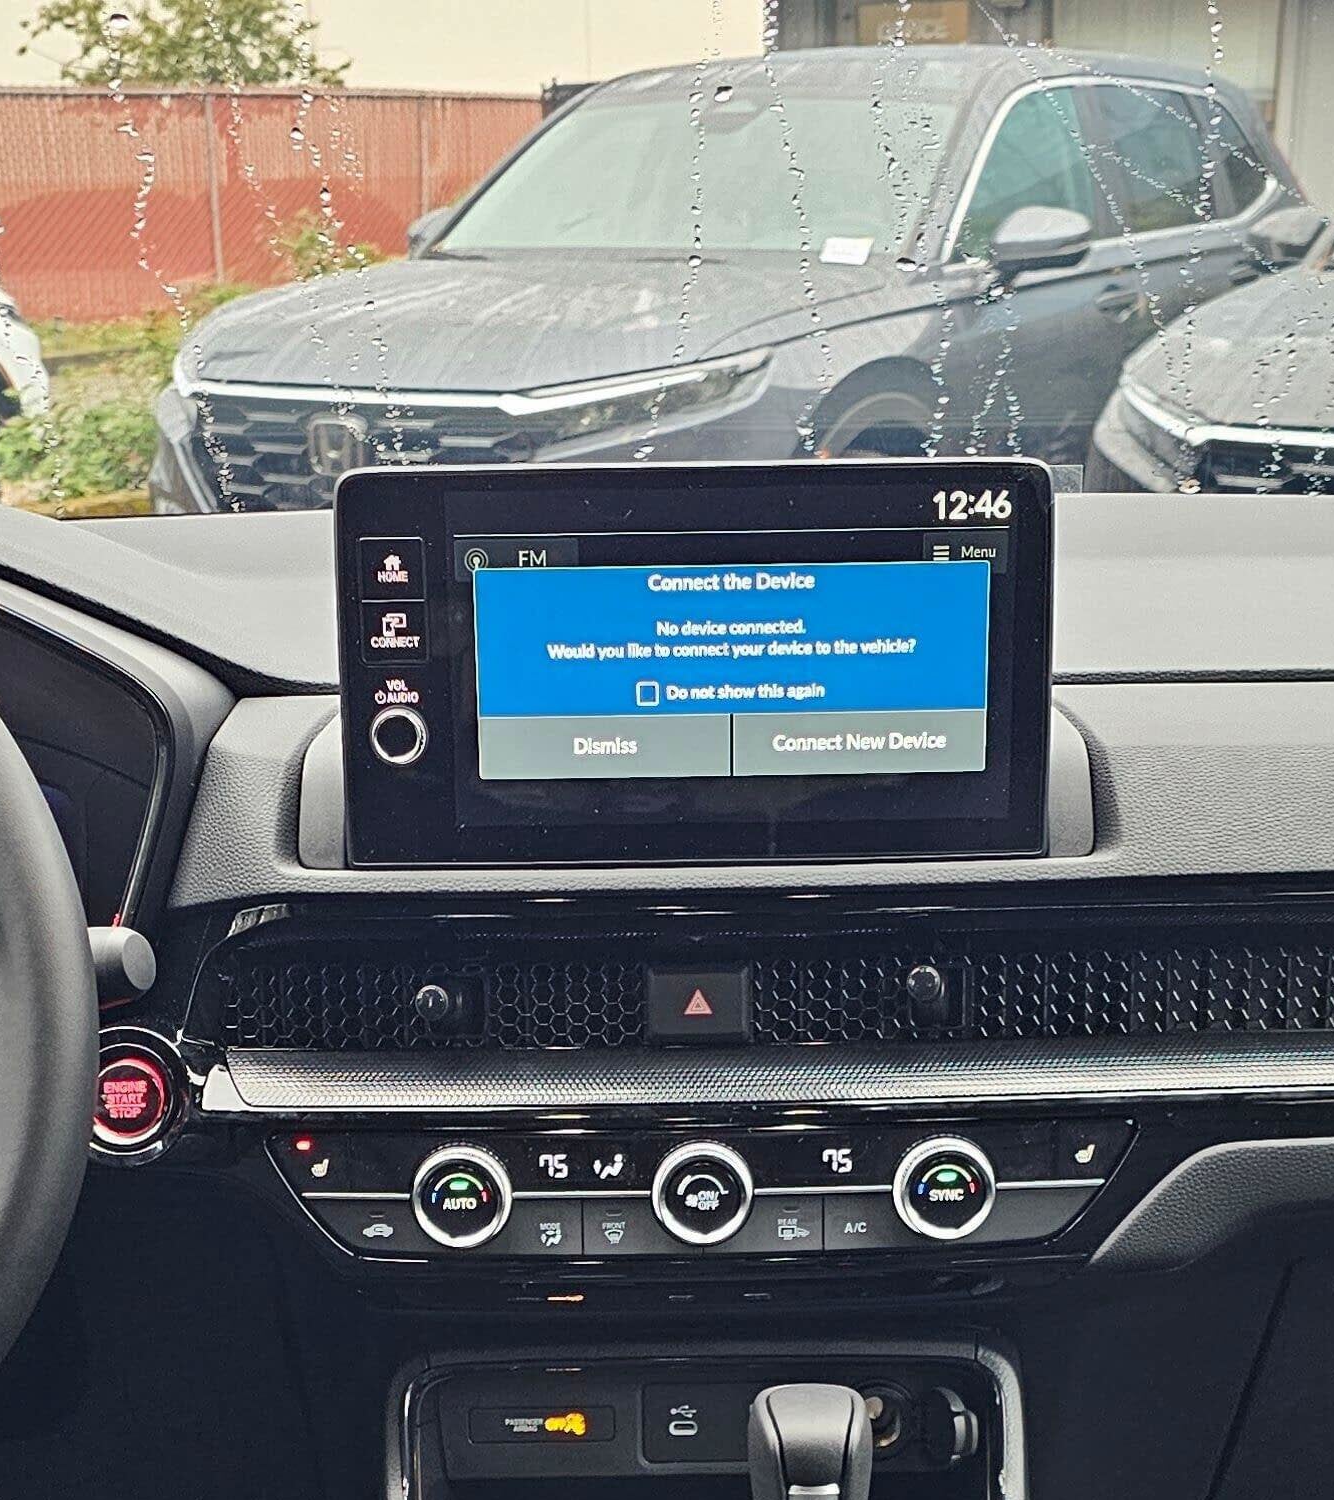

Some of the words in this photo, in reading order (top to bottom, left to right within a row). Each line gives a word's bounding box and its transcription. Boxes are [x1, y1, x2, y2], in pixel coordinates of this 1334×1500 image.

[932, 489, 1012, 520] 12:46
[961, 545, 996, 558] Menu
[518, 549, 547, 568] FM
[377, 571, 409, 584] HOME
[647, 573, 720, 592] Connect
[723, 573, 752, 590] the
[755, 571, 816, 590] Device
[656, 621, 679, 636] No
[680, 619, 728, 636] device
[728, 618, 806, 635] connected.
[370, 636, 421, 649] CONNECT
[547, 643, 595, 660] Would
[598, 645, 624, 661] you
[627, 642, 652, 658] like
[654, 643, 671, 658] to
[672, 642, 730, 658] connect
[731, 642, 765, 659] your
[766, 639, 813, 656] device
[814, 640, 831, 655] to
[833, 638, 859, 654] the
[860, 637, 917, 654] vehicle?
[385, 679, 409, 692] VOL
[665, 684, 687, 700] Do
[690, 685, 716, 700] not
[717, 683, 756, 699] show
[757, 682, 785, 699] this
[787, 683, 826, 700] again
[386, 691, 420, 704] AUDIO
[573, 737, 638, 756] Dismiss
[772, 732, 843, 752] Connect
[845, 731, 887, 751] New
[889, 730, 947, 750] Device
[103, 1080, 147, 1093] ENGINE
[106, 1092, 144, 1105] START
[109, 1106, 142, 1119] STOP
[538, 1153, 569, 1179] 75
[822, 1148, 853, 1174] 75
[698, 1190, 719, 1201] ON/
[929, 1188, 964, 1202] SYNC
[442, 1197, 477, 1210] AUTO
[697, 1200, 719, 1211] OFF
[539, 1222, 561, 1231] MODE
[602, 1221, 626, 1230] FRONT
[844, 1221, 867, 1234] A/C
